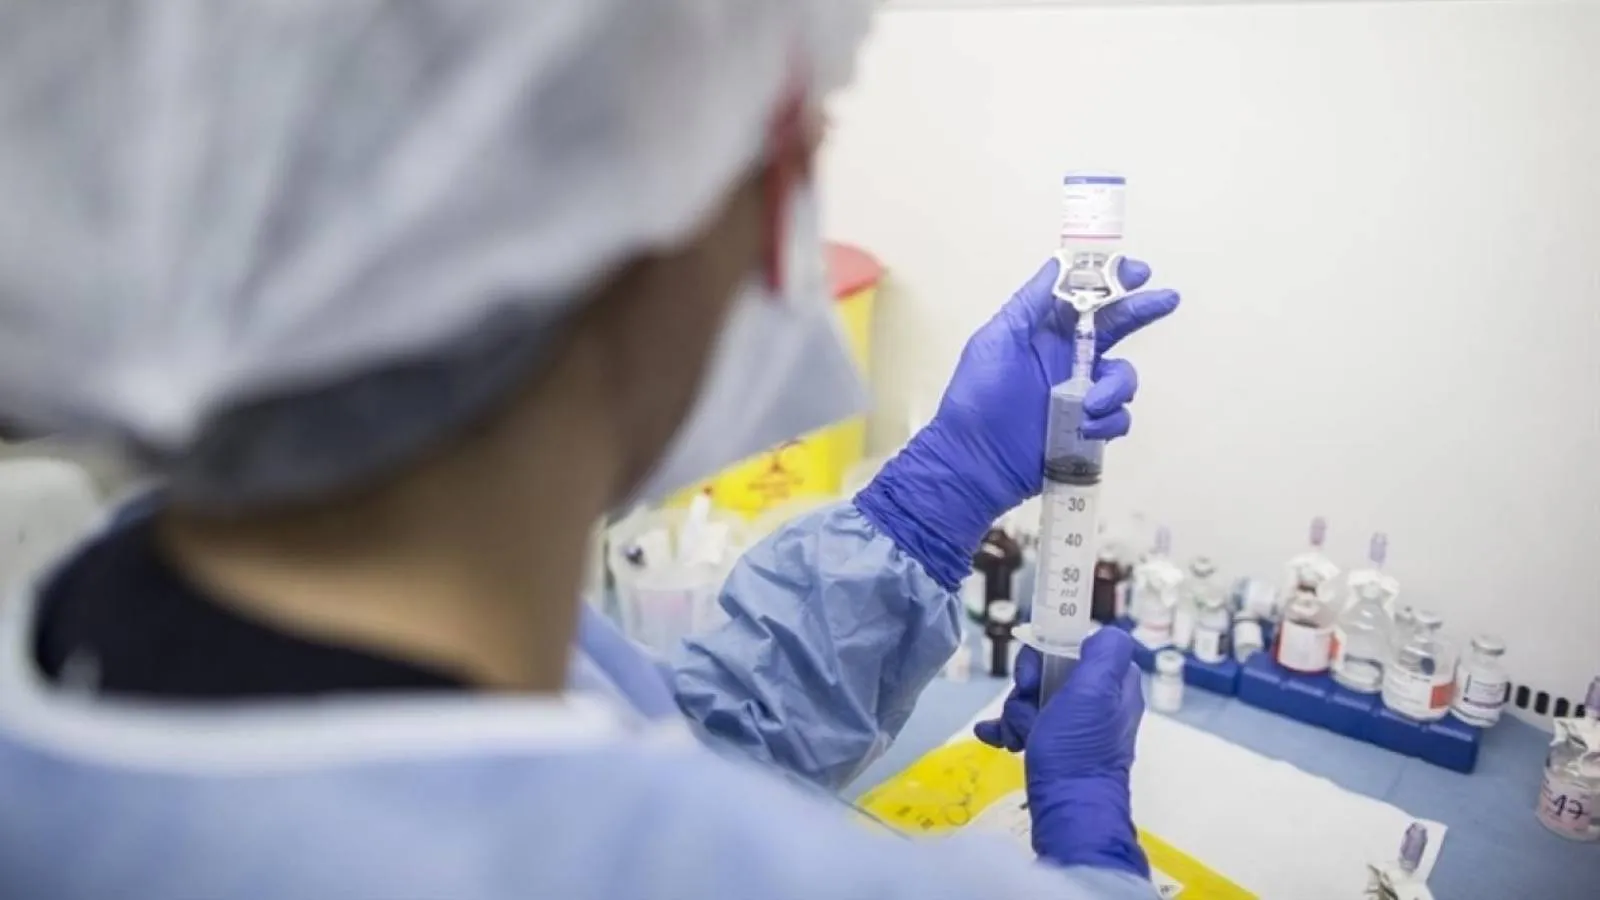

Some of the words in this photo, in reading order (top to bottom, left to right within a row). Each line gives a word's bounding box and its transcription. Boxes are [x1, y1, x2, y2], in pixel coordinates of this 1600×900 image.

[1068, 497, 1085, 512] 30
[1065, 533, 1083, 547] 40
[1062, 567, 1080, 583] 50
[1060, 587, 1079, 597] ml
[1059, 602, 1077, 617] 60
[1552, 794, 1588, 820] 17
